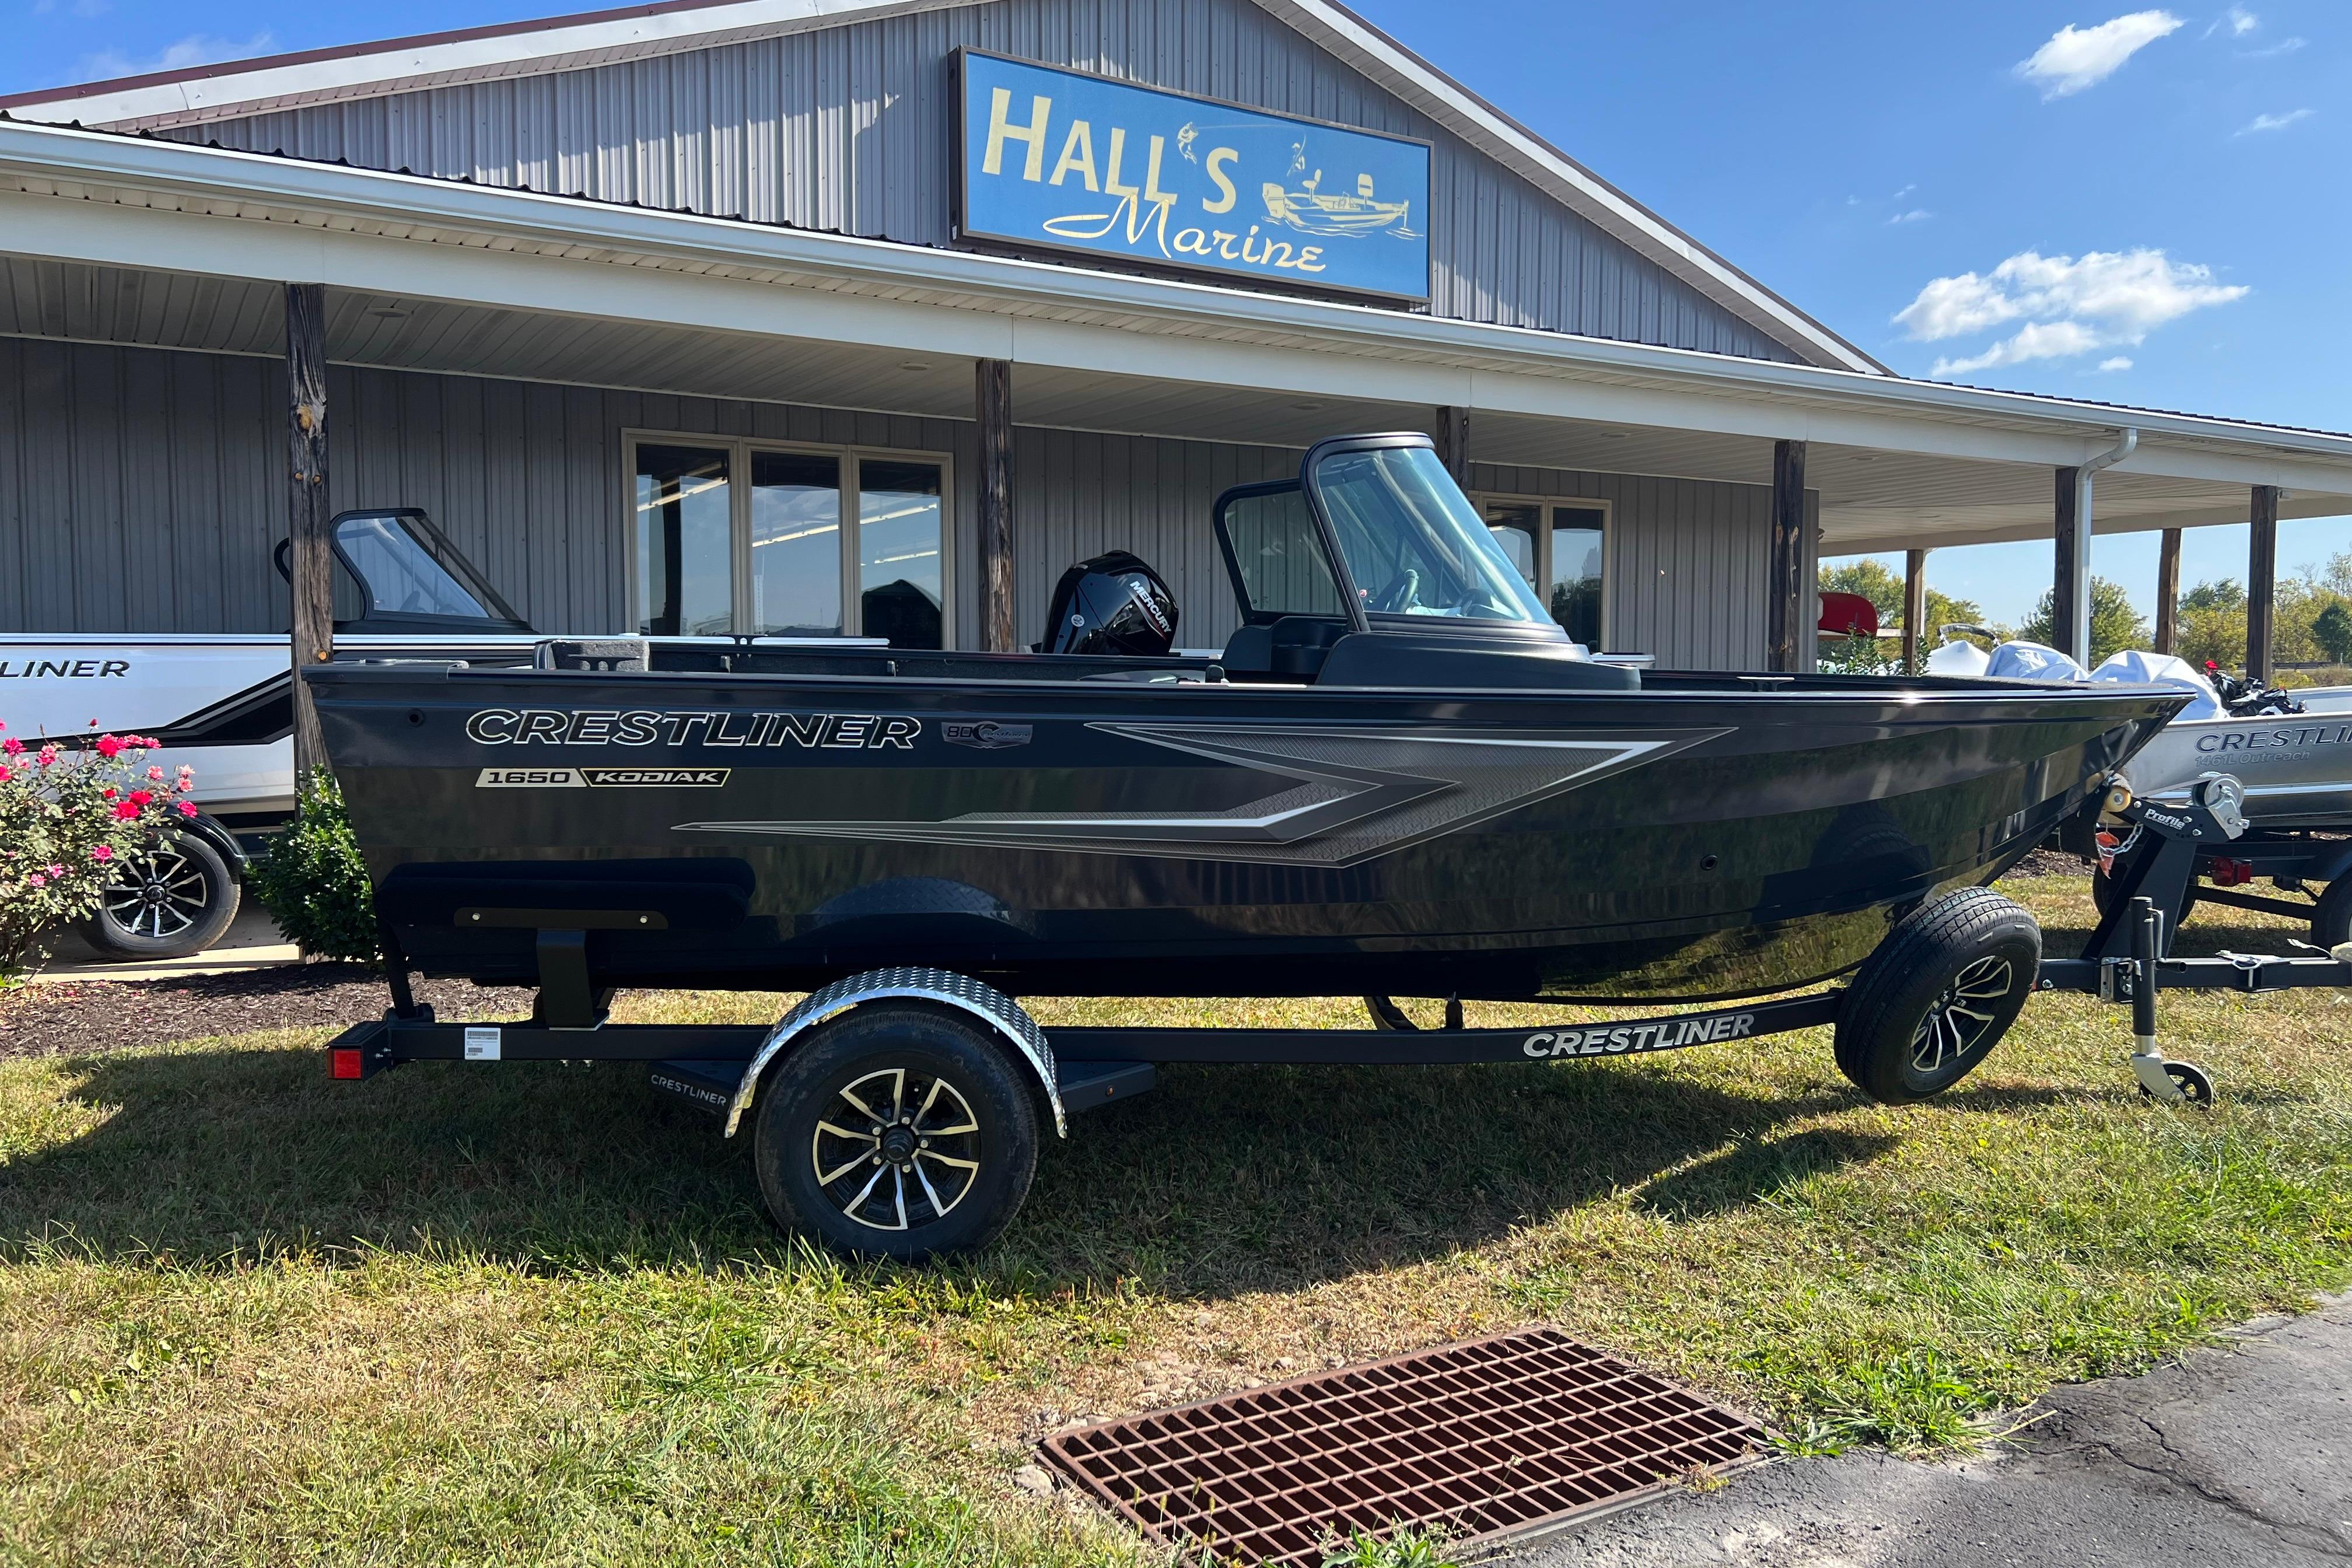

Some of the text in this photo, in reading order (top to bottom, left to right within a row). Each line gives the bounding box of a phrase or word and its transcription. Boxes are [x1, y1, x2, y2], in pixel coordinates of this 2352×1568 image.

[1042, 194, 1327, 272] Marine
[1130, 580, 1172, 634] MERCURY
[0, 659, 130, 678] LINER
[466, 708, 921, 750] CRESTLINER
[947, 726, 974, 738] 80
[2195, 750, 2311, 767] 1461L Outreach
[488, 771, 720, 784] 1650 KODIAK
[2145, 808, 2186, 828] Profile
[1523, 1014, 1755, 1058] CRESTLINER
[650, 1074, 727, 1107] CRESTLINER
